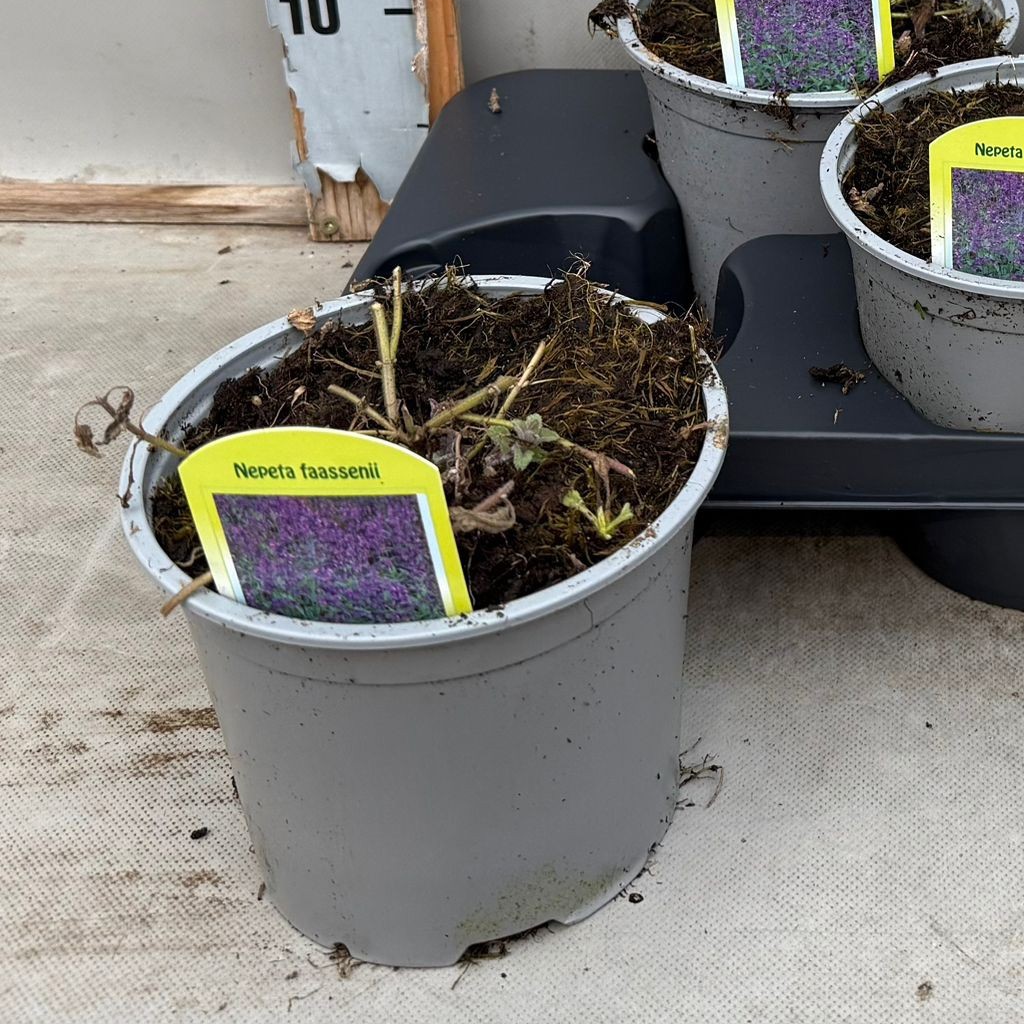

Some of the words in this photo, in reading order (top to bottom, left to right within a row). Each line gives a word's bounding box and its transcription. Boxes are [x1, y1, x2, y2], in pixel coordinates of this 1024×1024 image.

[974, 142, 1024, 159] Nepeta
[233, 462, 297, 480] Nepeta
[299, 462, 381, 480] faassenii
